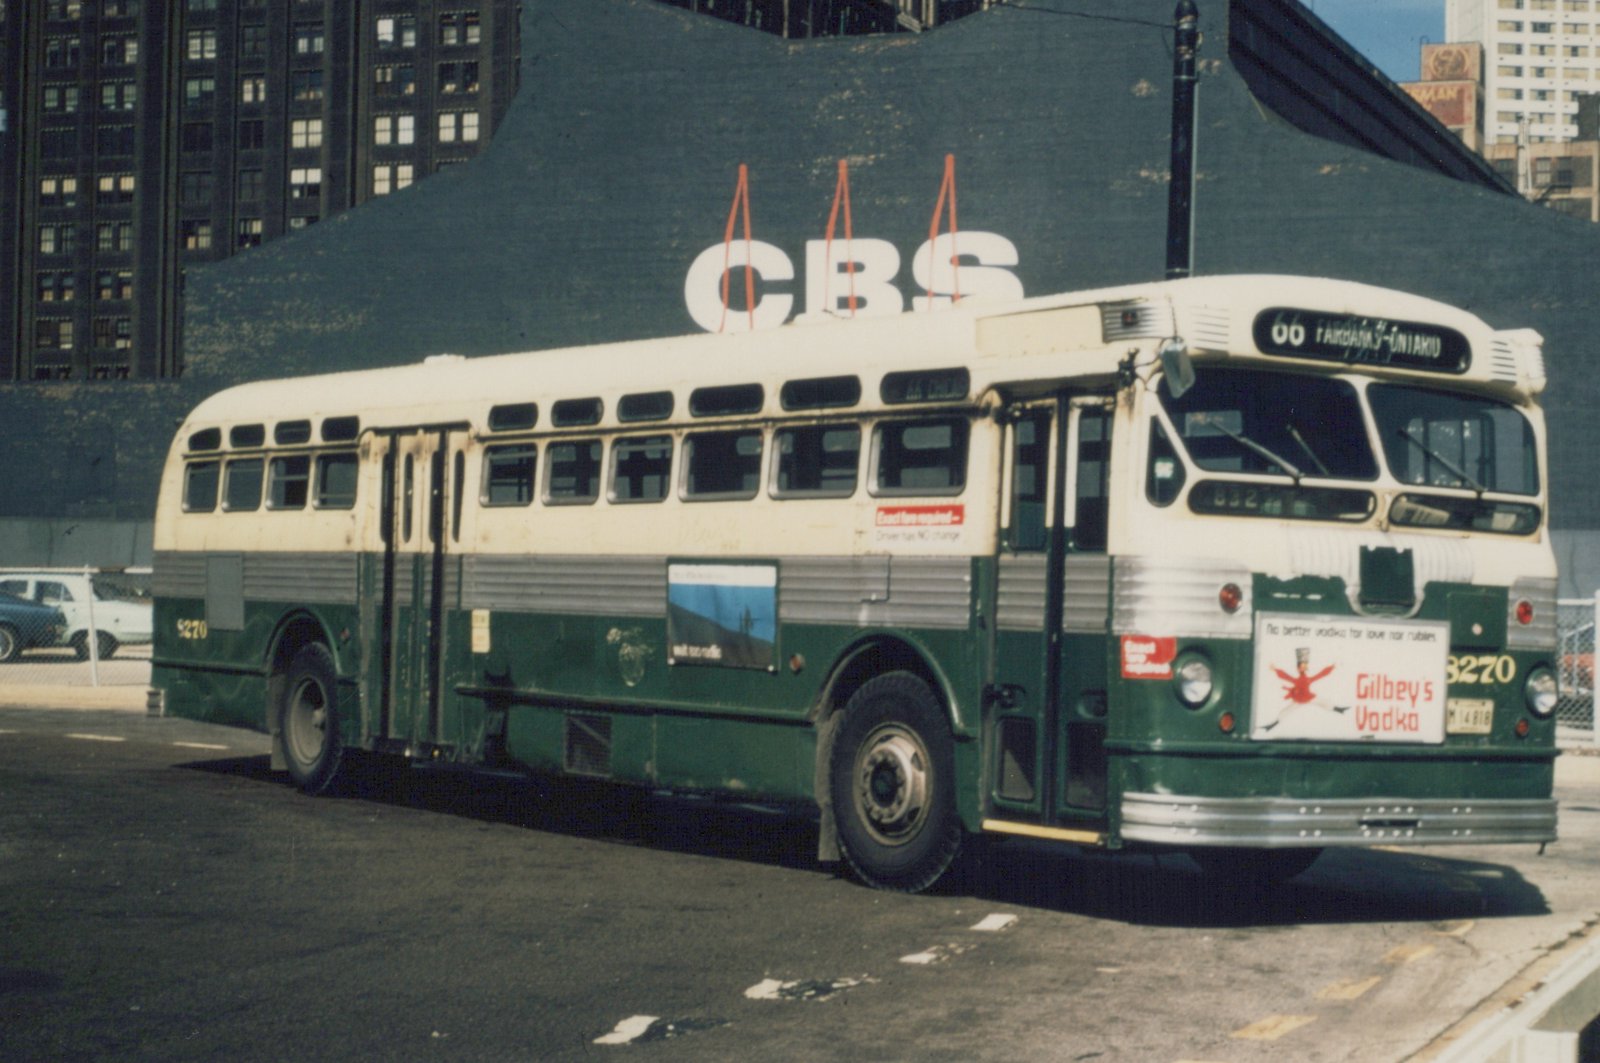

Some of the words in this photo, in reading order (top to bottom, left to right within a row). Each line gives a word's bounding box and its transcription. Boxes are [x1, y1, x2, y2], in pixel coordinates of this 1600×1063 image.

[684, 230, 1025, 333] CBS
[1271, 313, 1305, 346] 66
[917, 529, 930, 540] NO
[1266, 623, 1279, 635] No
[1282, 624, 1311, 637] better
[1315, 625, 1346, 638] vodka
[1350, 626, 1363, 639] for
[1366, 627, 1385, 640] love
[1388, 630, 1404, 641] nor
[1356, 673, 1434, 708] Gilbey's
[1355, 704, 1420, 732] Vodka
